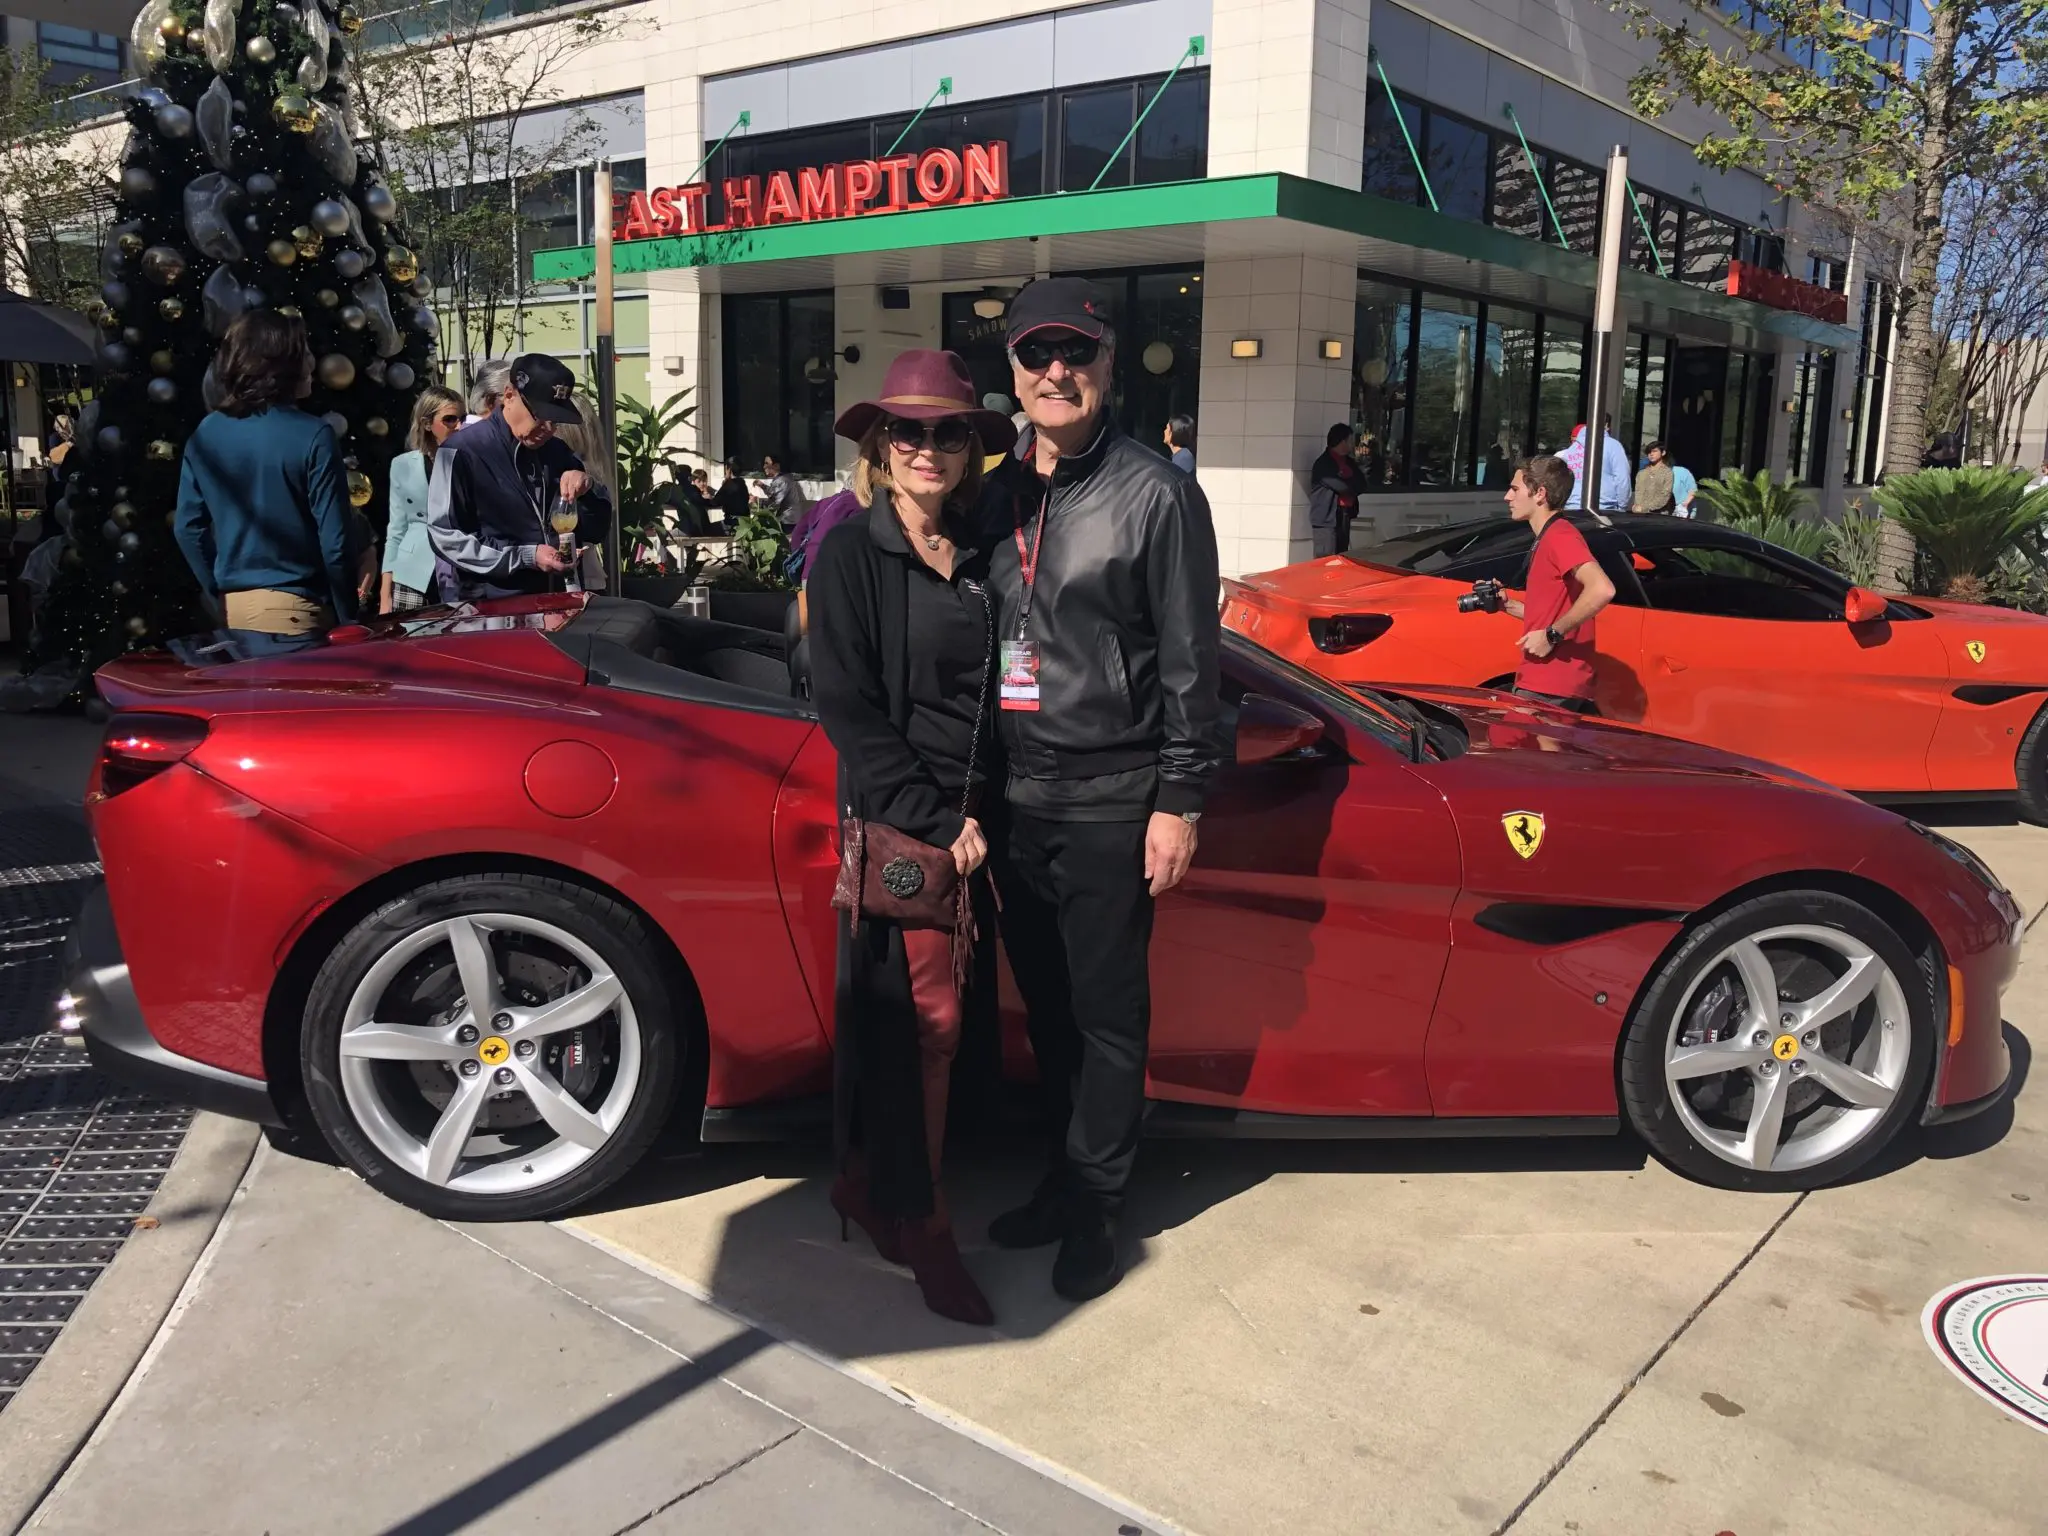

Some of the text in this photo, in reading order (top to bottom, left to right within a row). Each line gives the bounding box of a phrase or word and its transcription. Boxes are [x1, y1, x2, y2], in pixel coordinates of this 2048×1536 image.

[612, 139, 1010, 242] AST HAMPTON
[968, 318, 1008, 341] SANDW
[1995, 1286, 2045, 1296] CANCE
